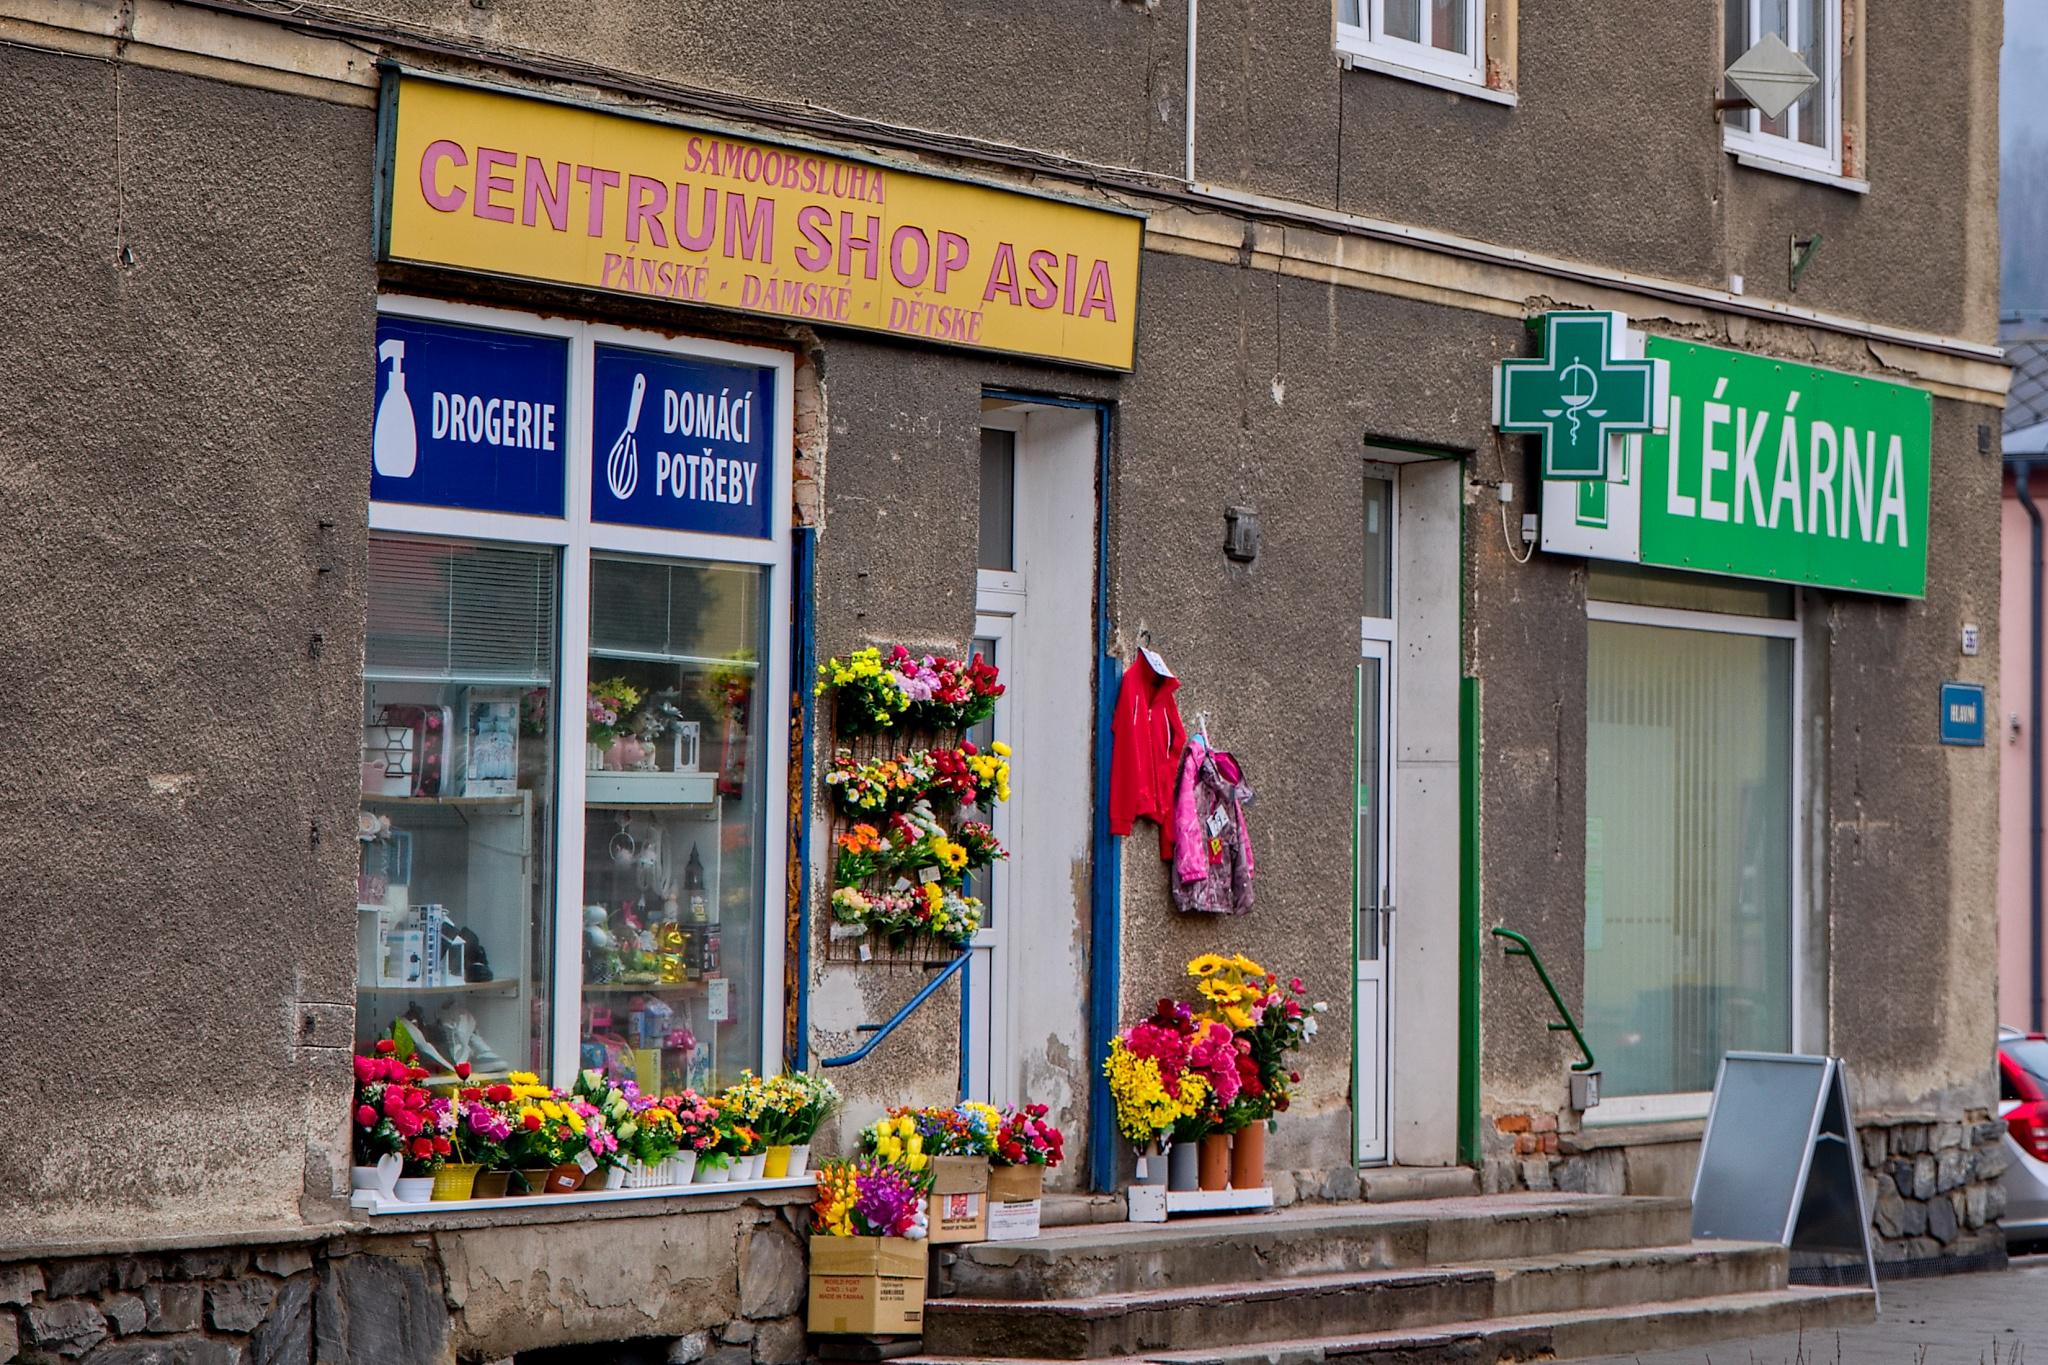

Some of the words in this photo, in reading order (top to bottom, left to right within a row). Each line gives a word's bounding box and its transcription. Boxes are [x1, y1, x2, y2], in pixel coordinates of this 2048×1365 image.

[684, 137, 886, 205] SAMOOBSLUHA
[420, 140, 774, 263] CENTRUM
[794, 206, 970, 292] SHOP
[984, 243, 1116, 322] ASIA
[601, 245, 710, 301] PÁNSKÉ
[739, 269, 851, 323] DÁMSKÉ
[888, 288, 985, 344] DĚTSKÉ
[431, 391, 556, 451] DROGERIE
[664, 386, 753, 444] DOMÁCÍ
[656, 446, 758, 506] POTŘEBY
[1667, 376, 1909, 548] LÉKÁRNA
